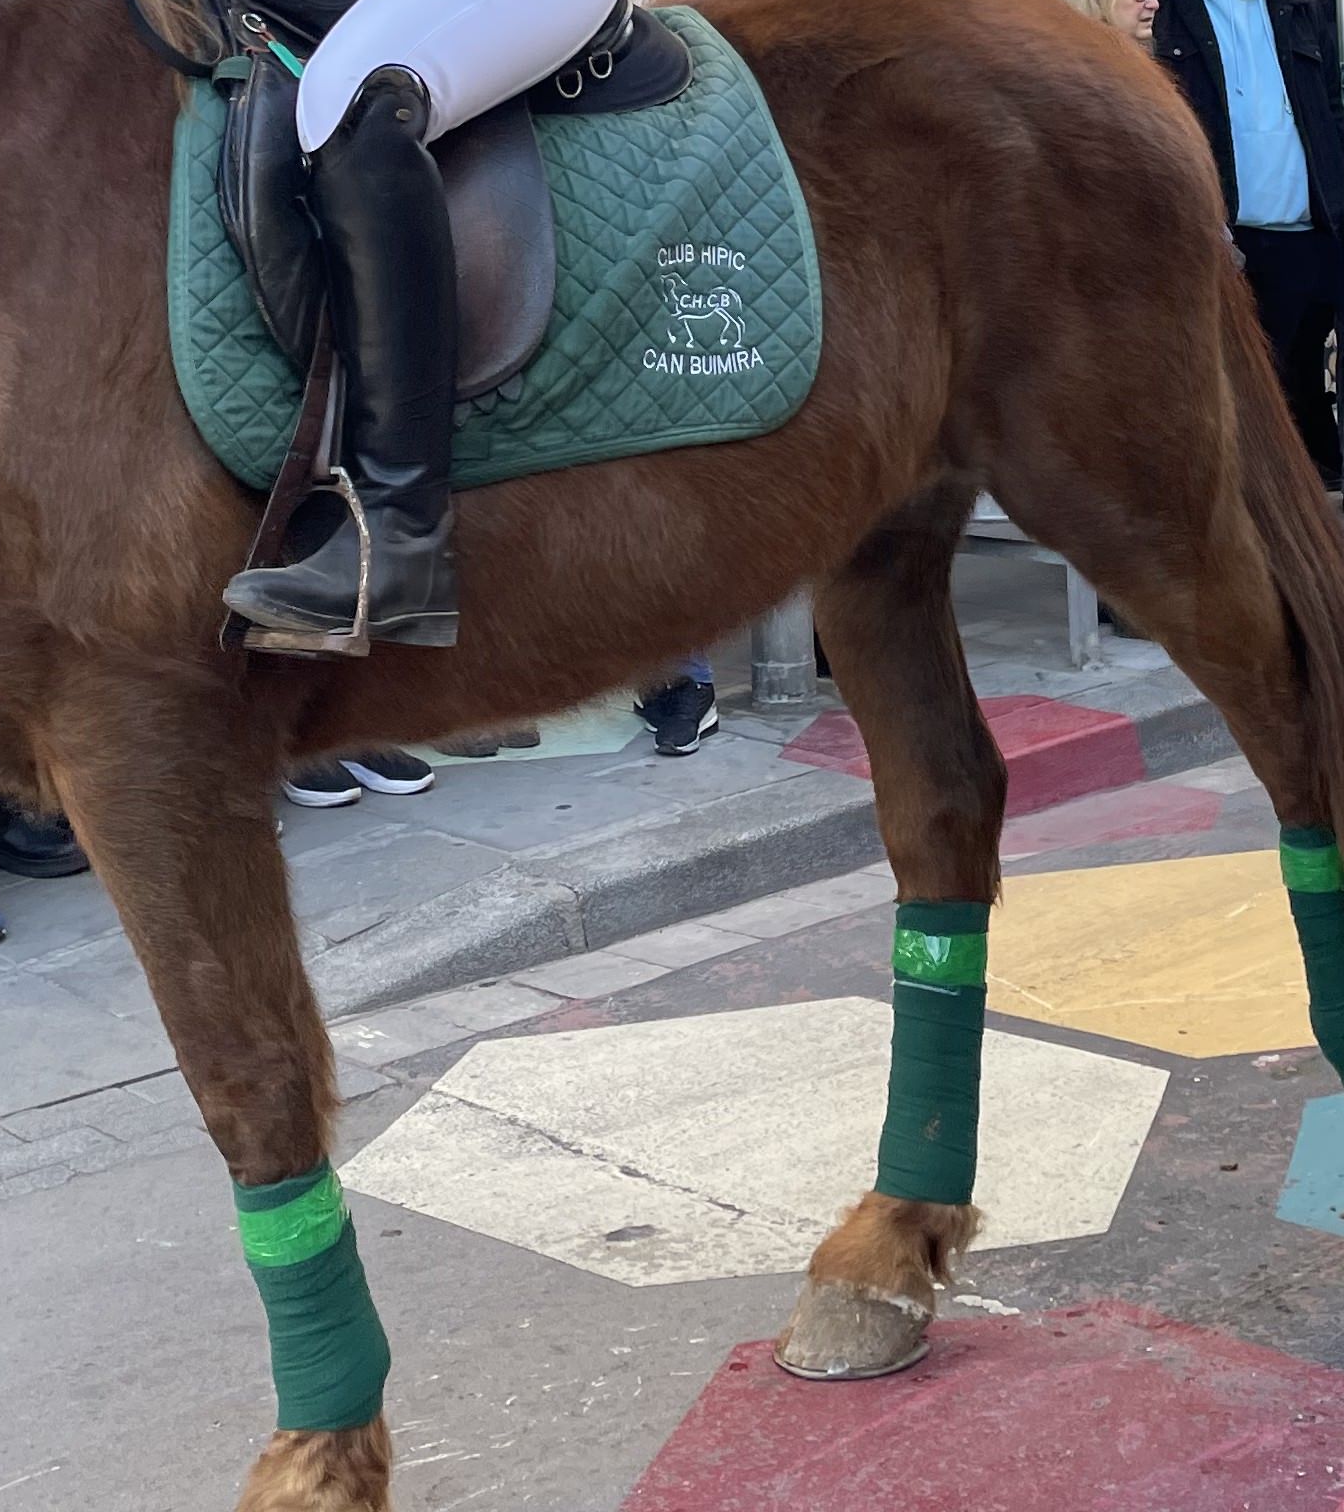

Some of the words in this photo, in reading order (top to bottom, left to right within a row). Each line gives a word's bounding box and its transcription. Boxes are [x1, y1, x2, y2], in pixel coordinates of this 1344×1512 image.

[657, 243, 694, 267] CLUB
[701, 245, 746, 271] HIPIC
[642, 348, 684, 375] CAN
[690, 347, 764, 375] BUIMIRA
